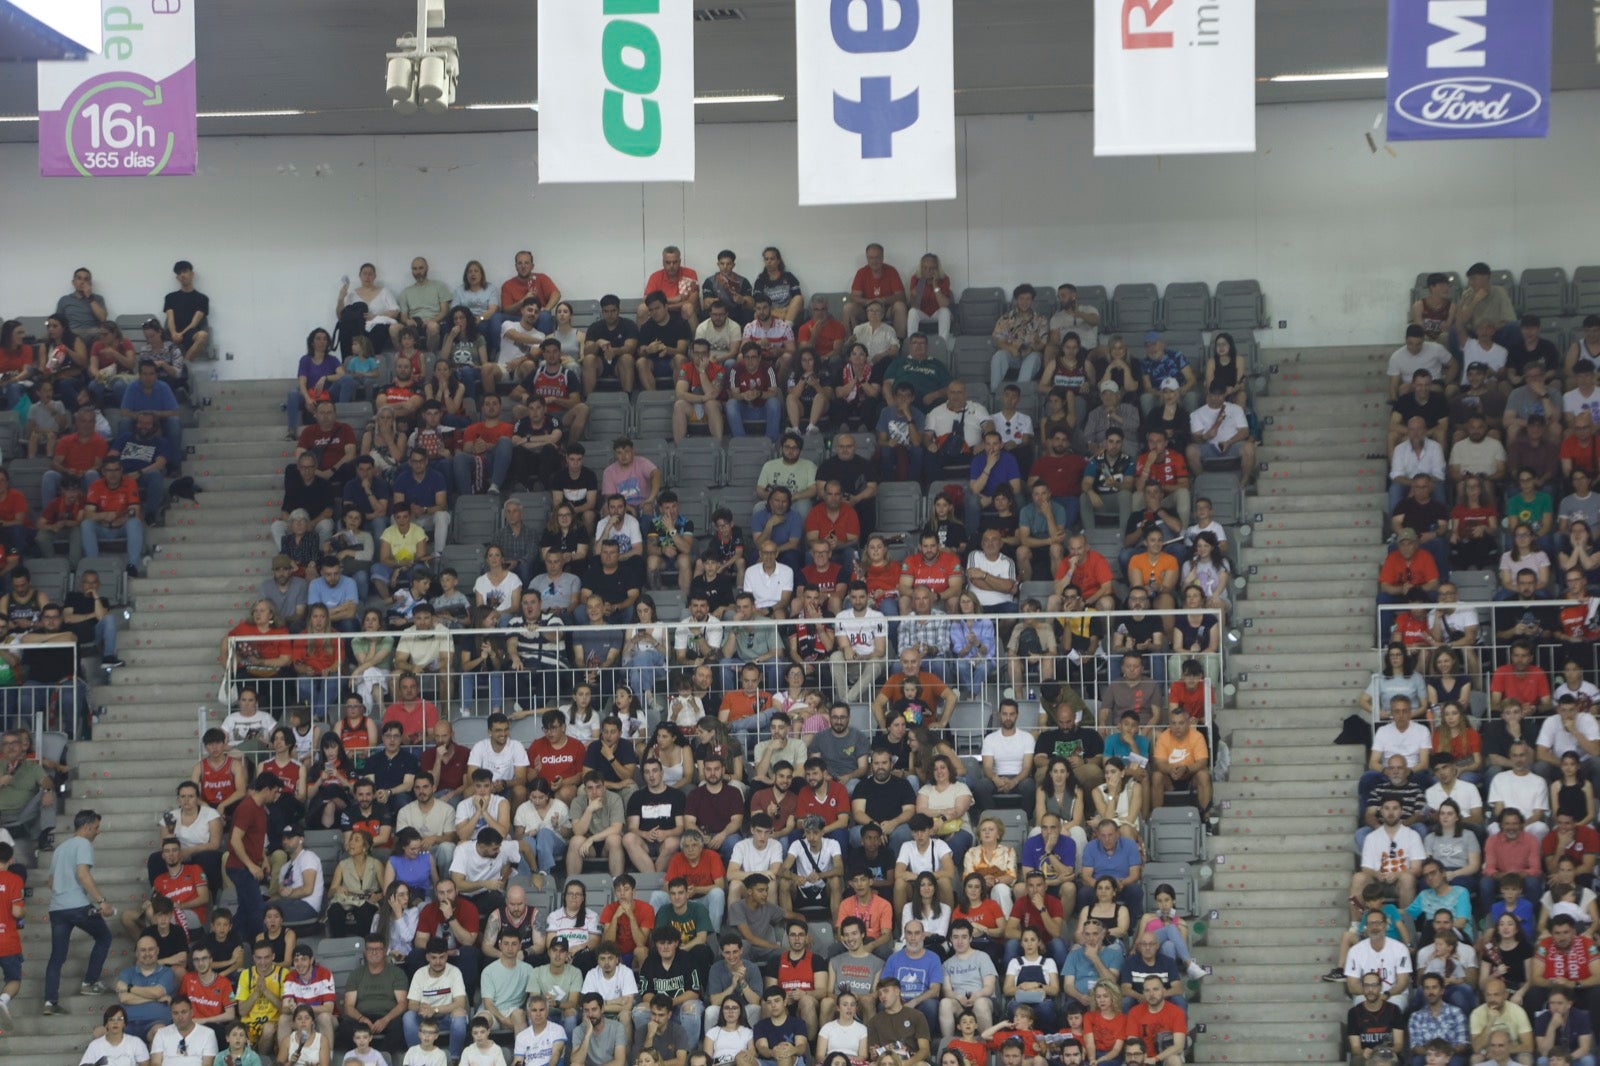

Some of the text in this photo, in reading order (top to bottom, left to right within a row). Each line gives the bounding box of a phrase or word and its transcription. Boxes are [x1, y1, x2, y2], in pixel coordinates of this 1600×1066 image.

[1189, 0, 1220, 47] im
[1421, 82, 1512, 122] Ford
[82, 102, 156, 149] 16h
[84, 150, 156, 168] 365 días
[541, 754, 574, 765] adidas
